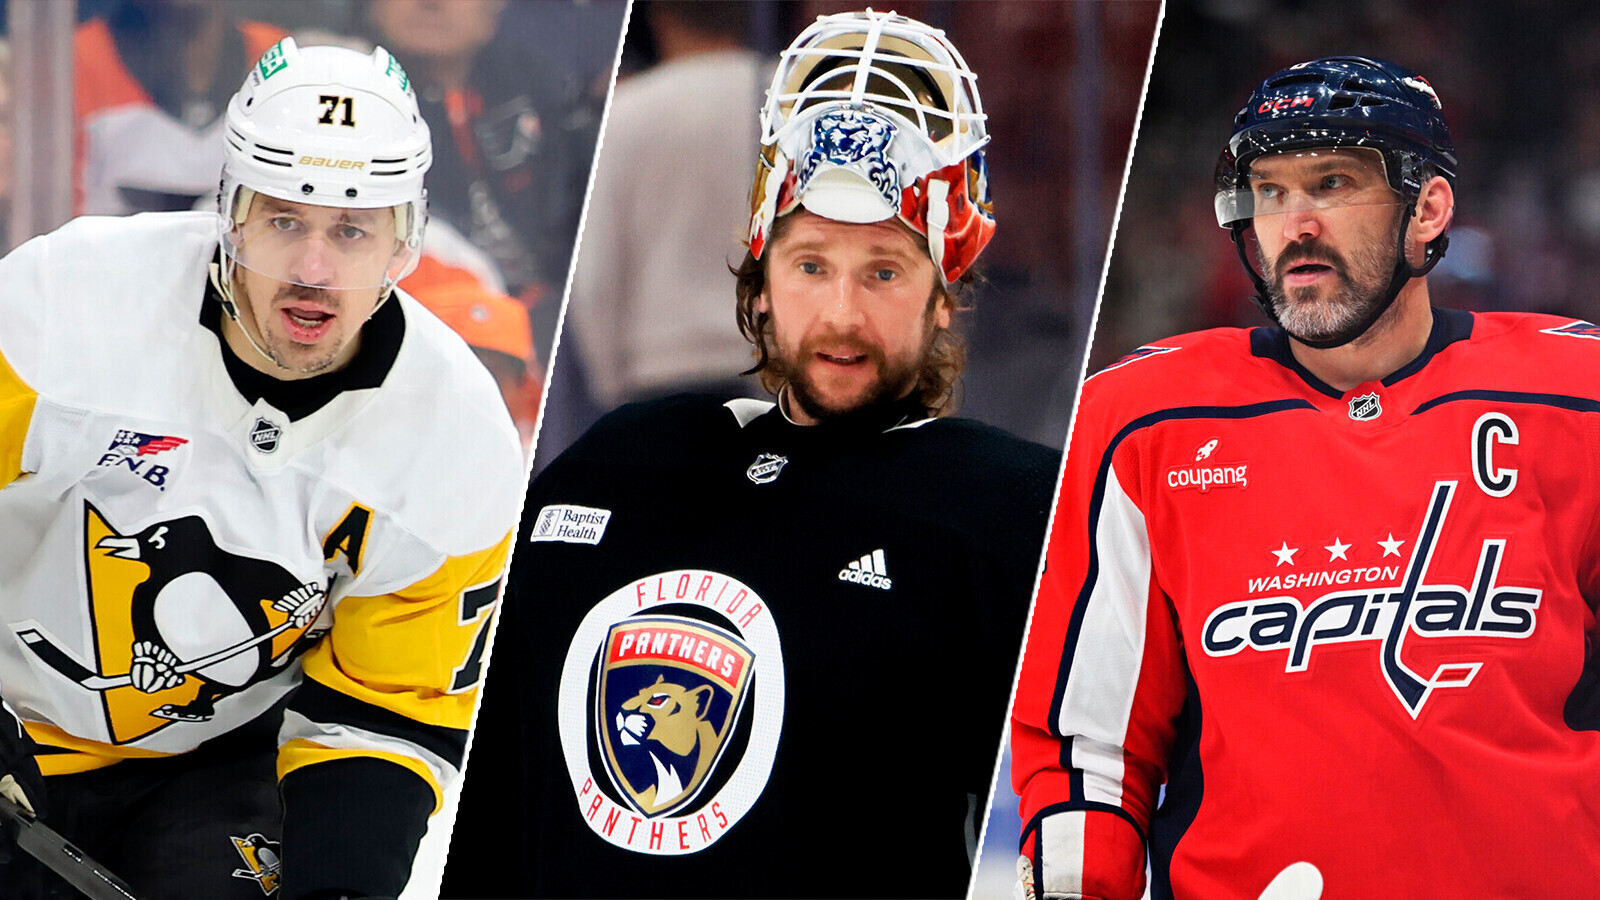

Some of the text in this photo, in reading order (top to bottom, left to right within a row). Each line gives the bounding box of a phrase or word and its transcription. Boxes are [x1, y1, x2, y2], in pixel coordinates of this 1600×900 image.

[318, 95, 356, 127] 71
[1258, 97, 1315, 114] CCM
[299, 156, 365, 170] BAUER
[1356, 401, 1375, 417] NHL
[254, 431, 276, 442] NHL
[1471, 412, 1520, 498] C
[1167, 465, 1248, 490] coupang
[562, 508, 606, 526] Baptist
[322, 501, 375, 578] A
[556, 524, 597, 540] Health
[838, 567, 893, 590] adidas
[1248, 566, 1400, 594] WASHINGTON
[635, 573, 763, 629] FLORIDA
[618, 632, 737, 678] PANTHERS
[579, 776, 729, 850] PANTHERS
